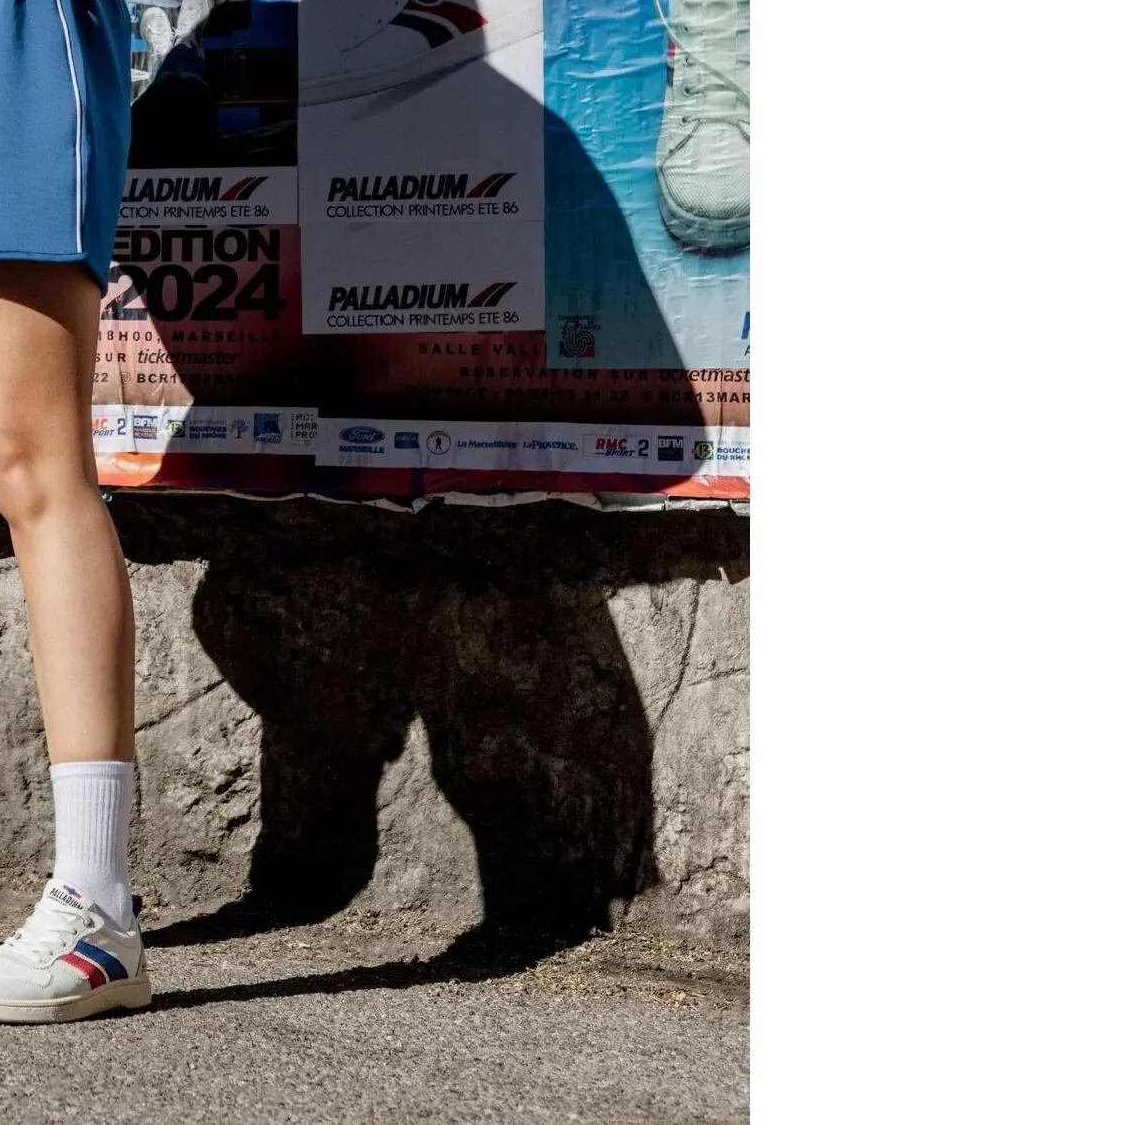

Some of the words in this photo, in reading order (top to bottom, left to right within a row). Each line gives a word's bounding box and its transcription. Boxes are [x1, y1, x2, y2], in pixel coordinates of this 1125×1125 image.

[122, 177, 223, 203] LADIUM
[328, 173, 469, 202] PALLADIUM
[163, 206, 228, 218] PRINTEMPS
[230, 205, 251, 217] ETE
[254, 205, 270, 217] 86
[326, 204, 404, 219] COLLECTION
[408, 203, 475, 216] PRINTEMPS
[478, 202, 499, 215] ETE
[502, 201, 519, 214] 86
[112, 228, 281, 263] EDITION
[100, 263, 287, 322] 2024
[328, 283, 469, 311] PALLADIUM
[327, 314, 404, 328] COLLECTION
[409, 312, 475, 326] PRINTEMPS
[479, 312, 500, 324] ETE
[503, 311, 520, 324] 86
[138, 349, 238, 364] ticketmaster
[418, 343, 480, 355] SALLE
[117, 418, 127, 435] 2
[338, 445, 385, 454] MARSEILLE
[595, 438, 628, 450] RMC
[637, 439, 650, 457] 2
[658, 438, 684, 449] BFM
